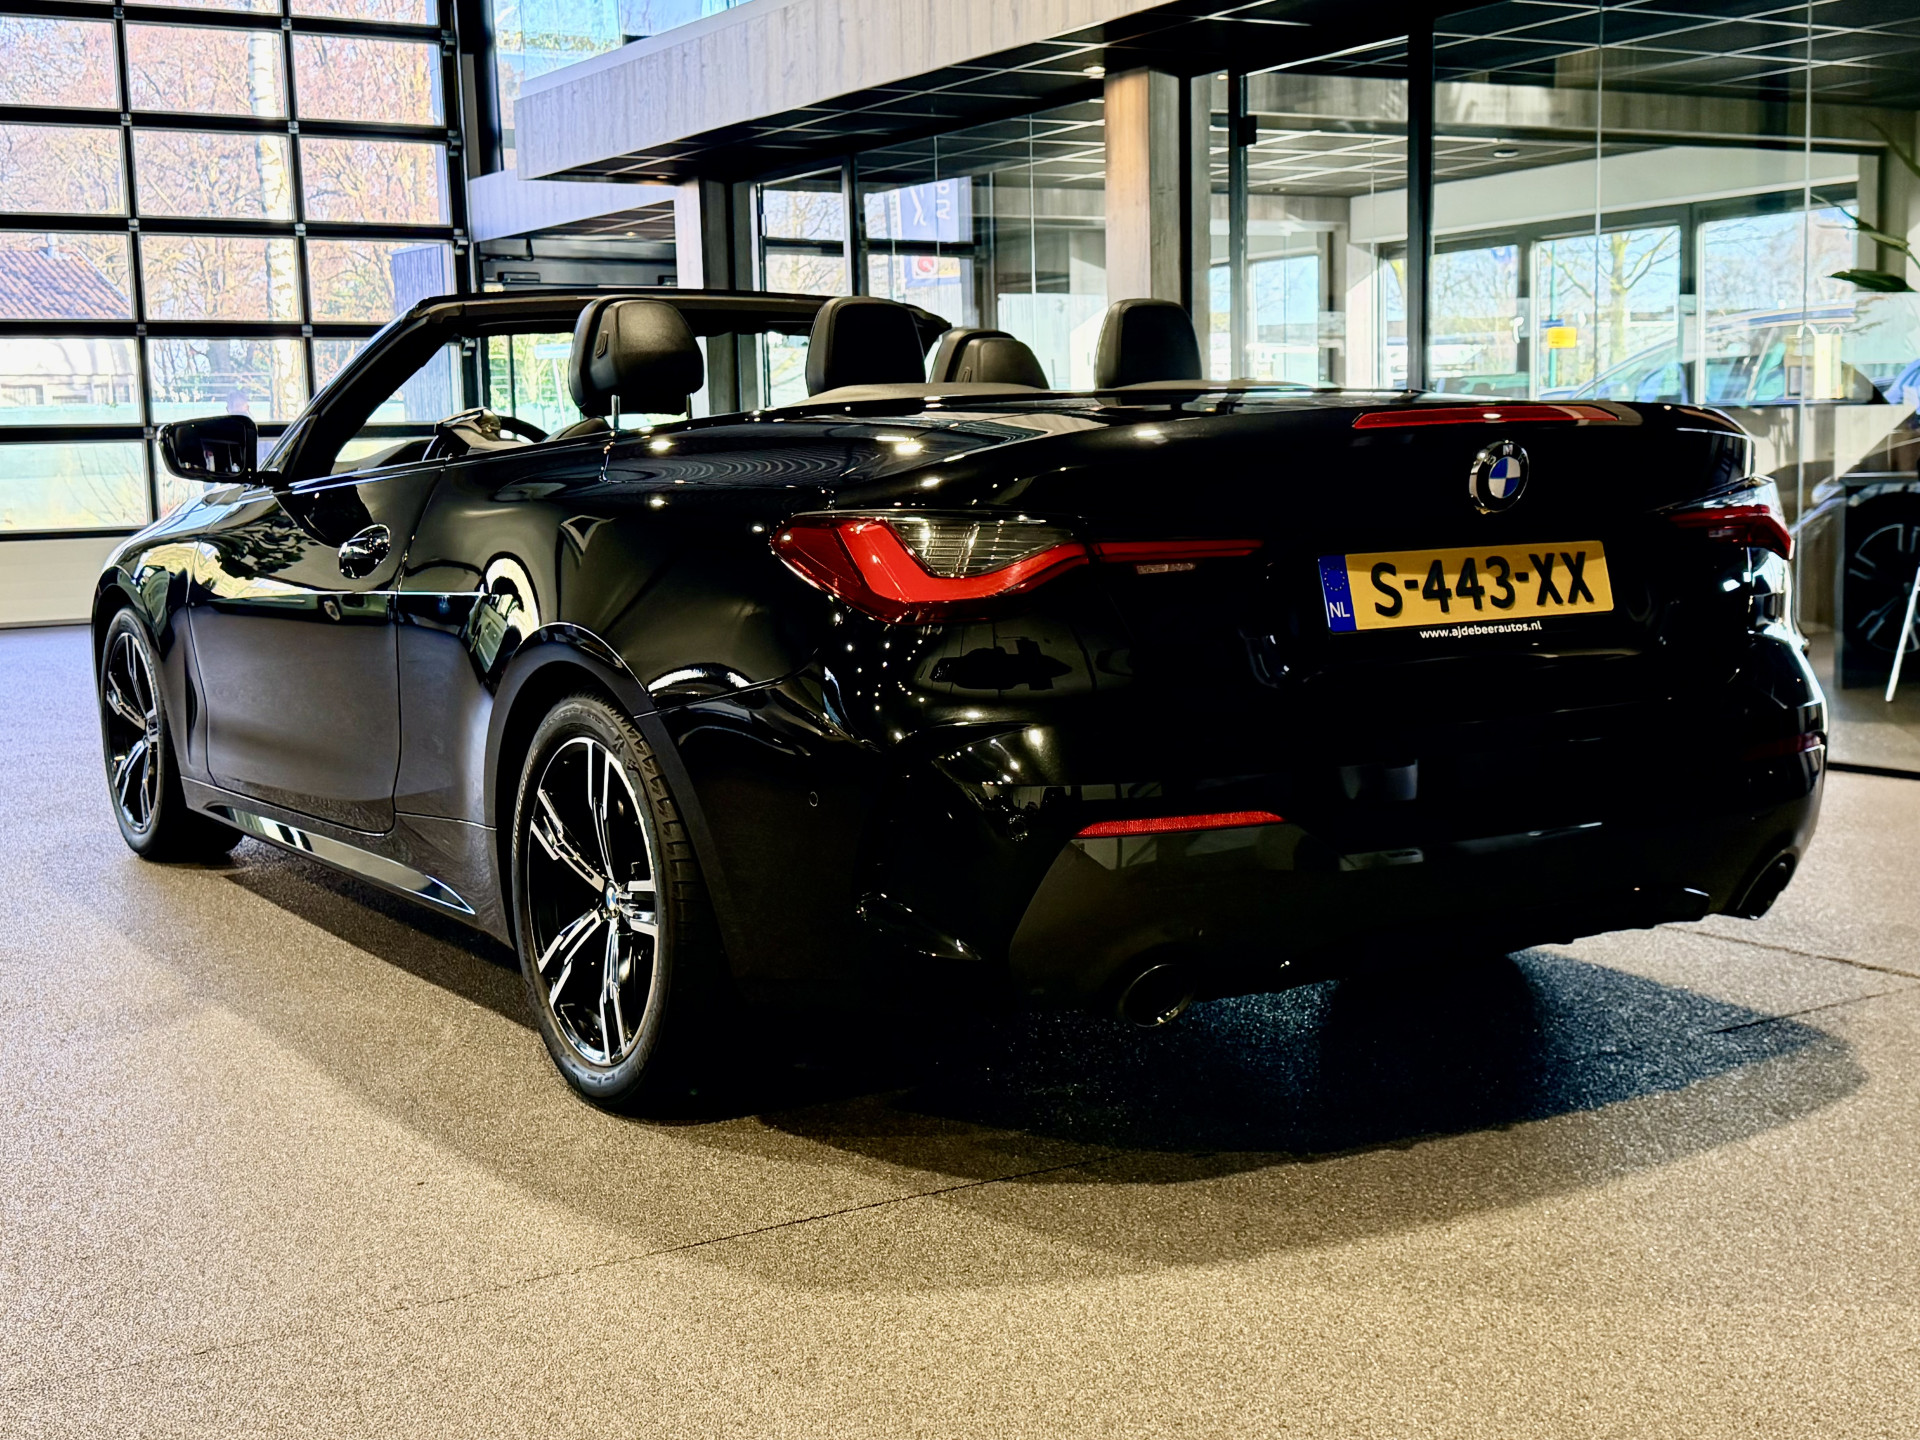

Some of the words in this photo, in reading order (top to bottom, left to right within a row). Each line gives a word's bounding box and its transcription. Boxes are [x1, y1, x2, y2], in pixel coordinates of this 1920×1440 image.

[1371, 551, 1595, 617] S-443-XX
[1329, 601, 1350, 618] NL
[1419, 620, 1543, 638] www.ajdebeerautos.nl
